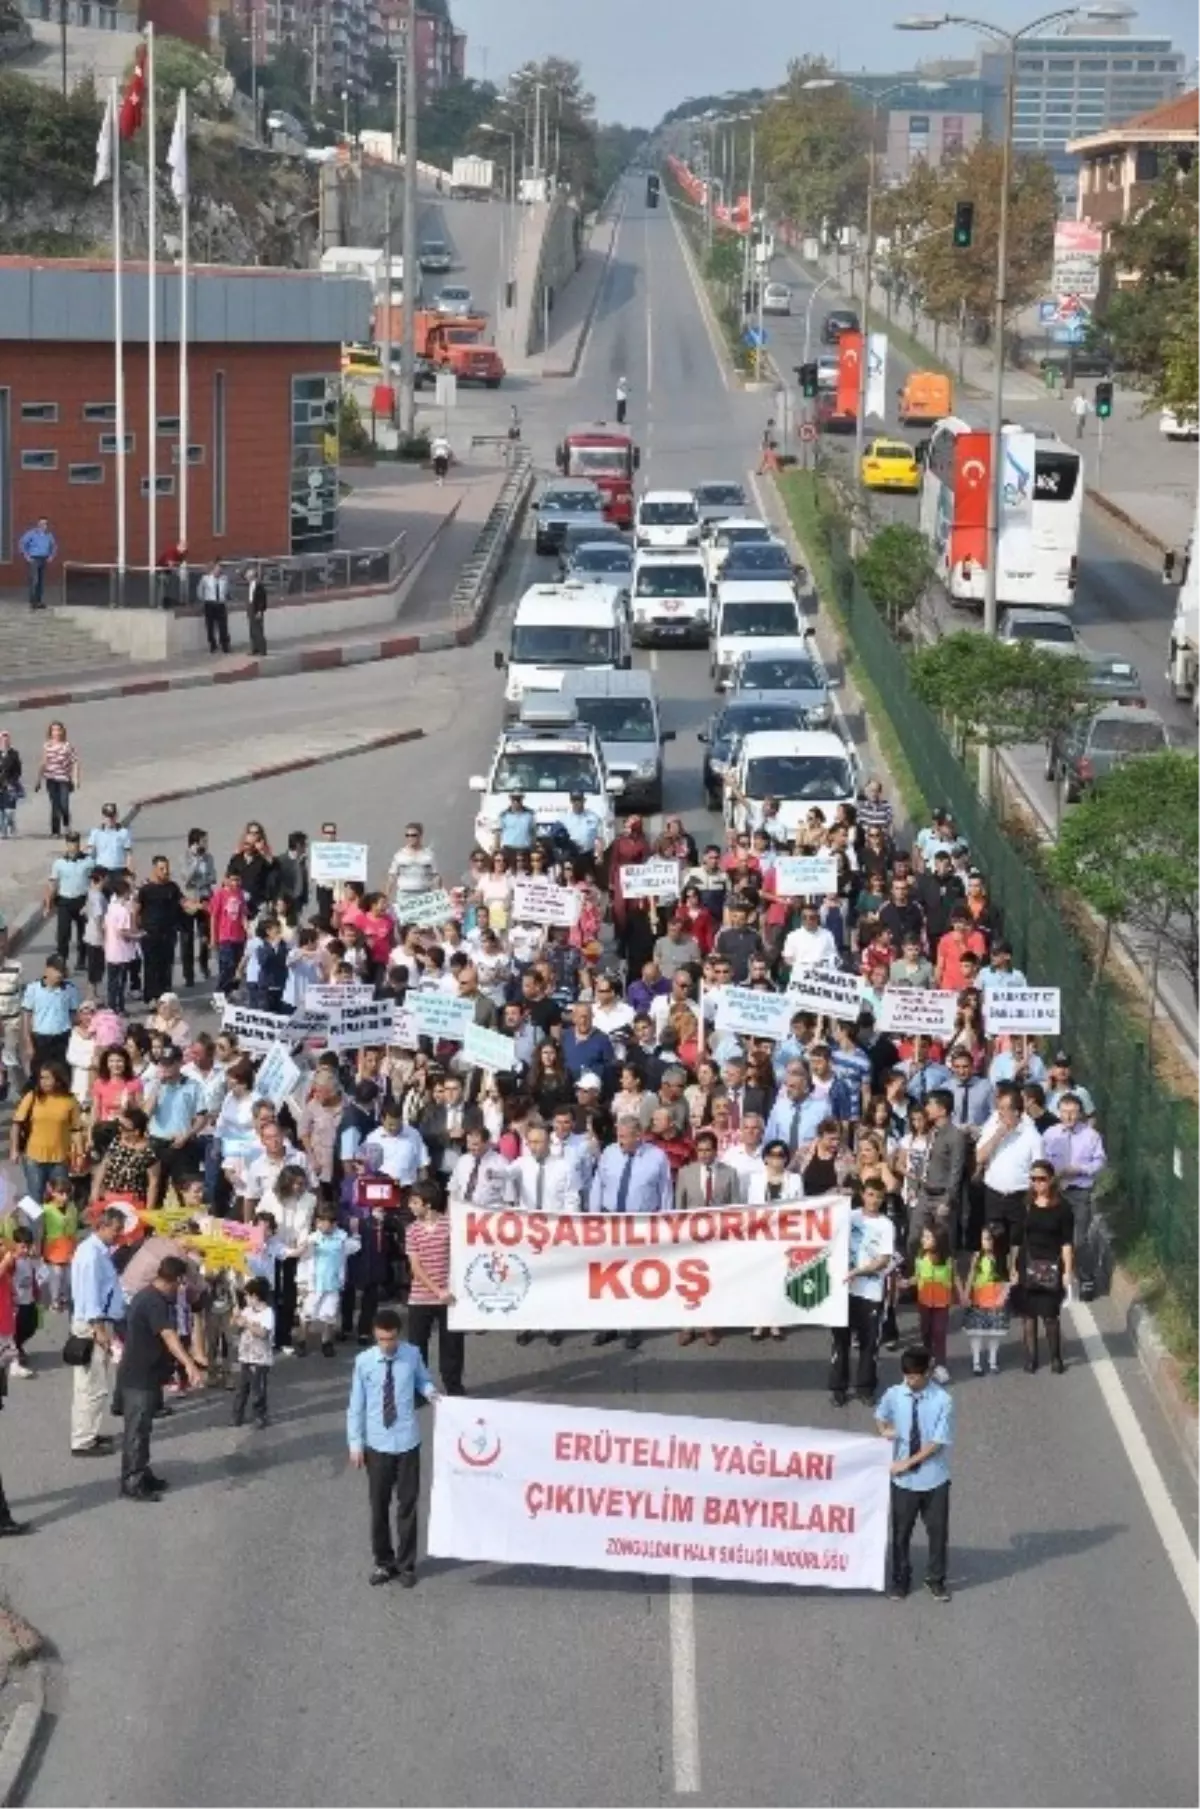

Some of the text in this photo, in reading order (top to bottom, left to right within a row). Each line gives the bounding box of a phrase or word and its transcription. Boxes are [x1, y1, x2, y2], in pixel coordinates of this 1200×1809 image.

[588, 1258, 711, 1310] KOŞ
[555, 1429, 834, 1480] ERÜTELİM YAĞLARI
[525, 1482, 855, 1533] ÇIKIVEYLİM BAYIRLARI
